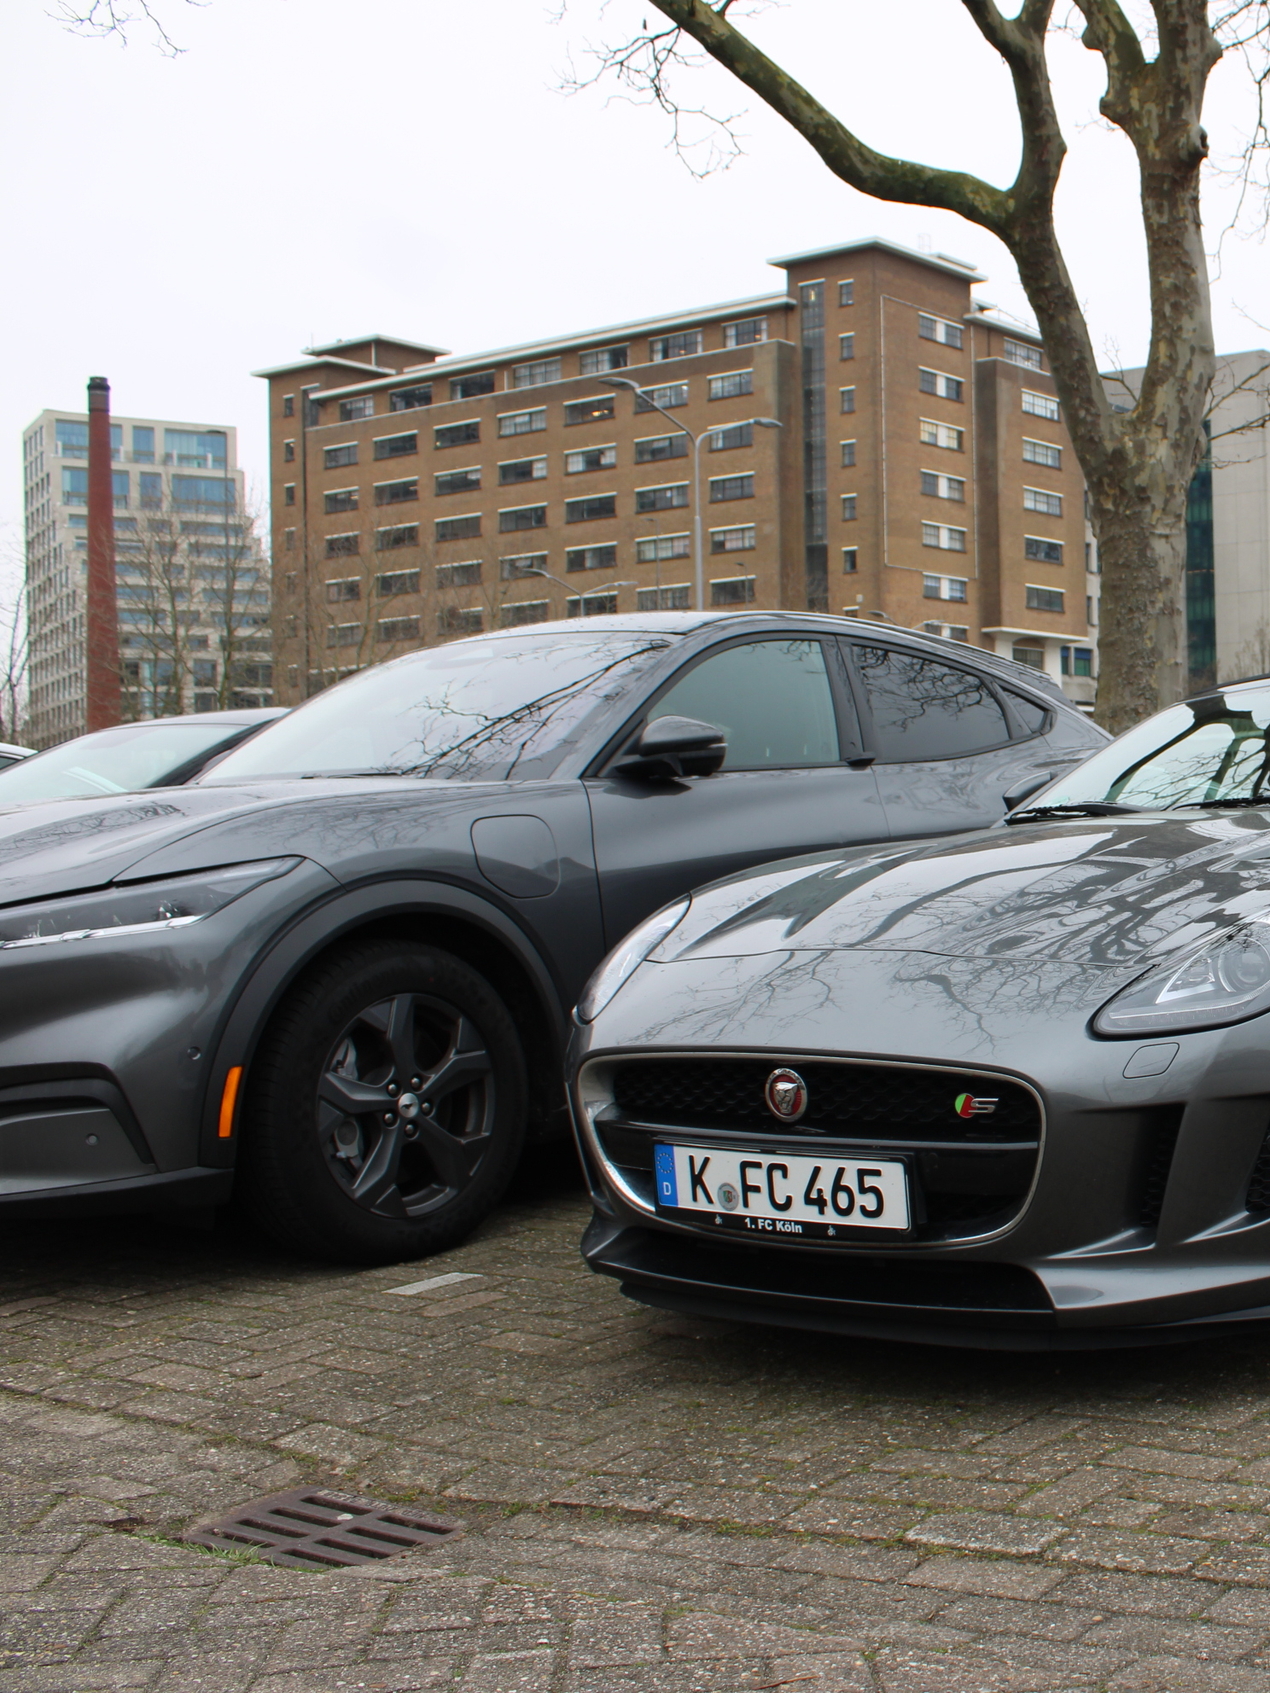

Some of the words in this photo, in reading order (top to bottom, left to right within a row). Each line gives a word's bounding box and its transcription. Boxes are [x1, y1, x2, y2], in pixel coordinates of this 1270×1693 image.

[662, 1181, 672, 1196] D
[688, 1154, 715, 1205] K
[739, 1160, 793, 1213] FC
[803, 1165, 885, 1219] 465
[744, 1217, 756, 1229] 1.
[757, 1219, 774, 1231] FC
[775, 1220, 803, 1234] Köln
